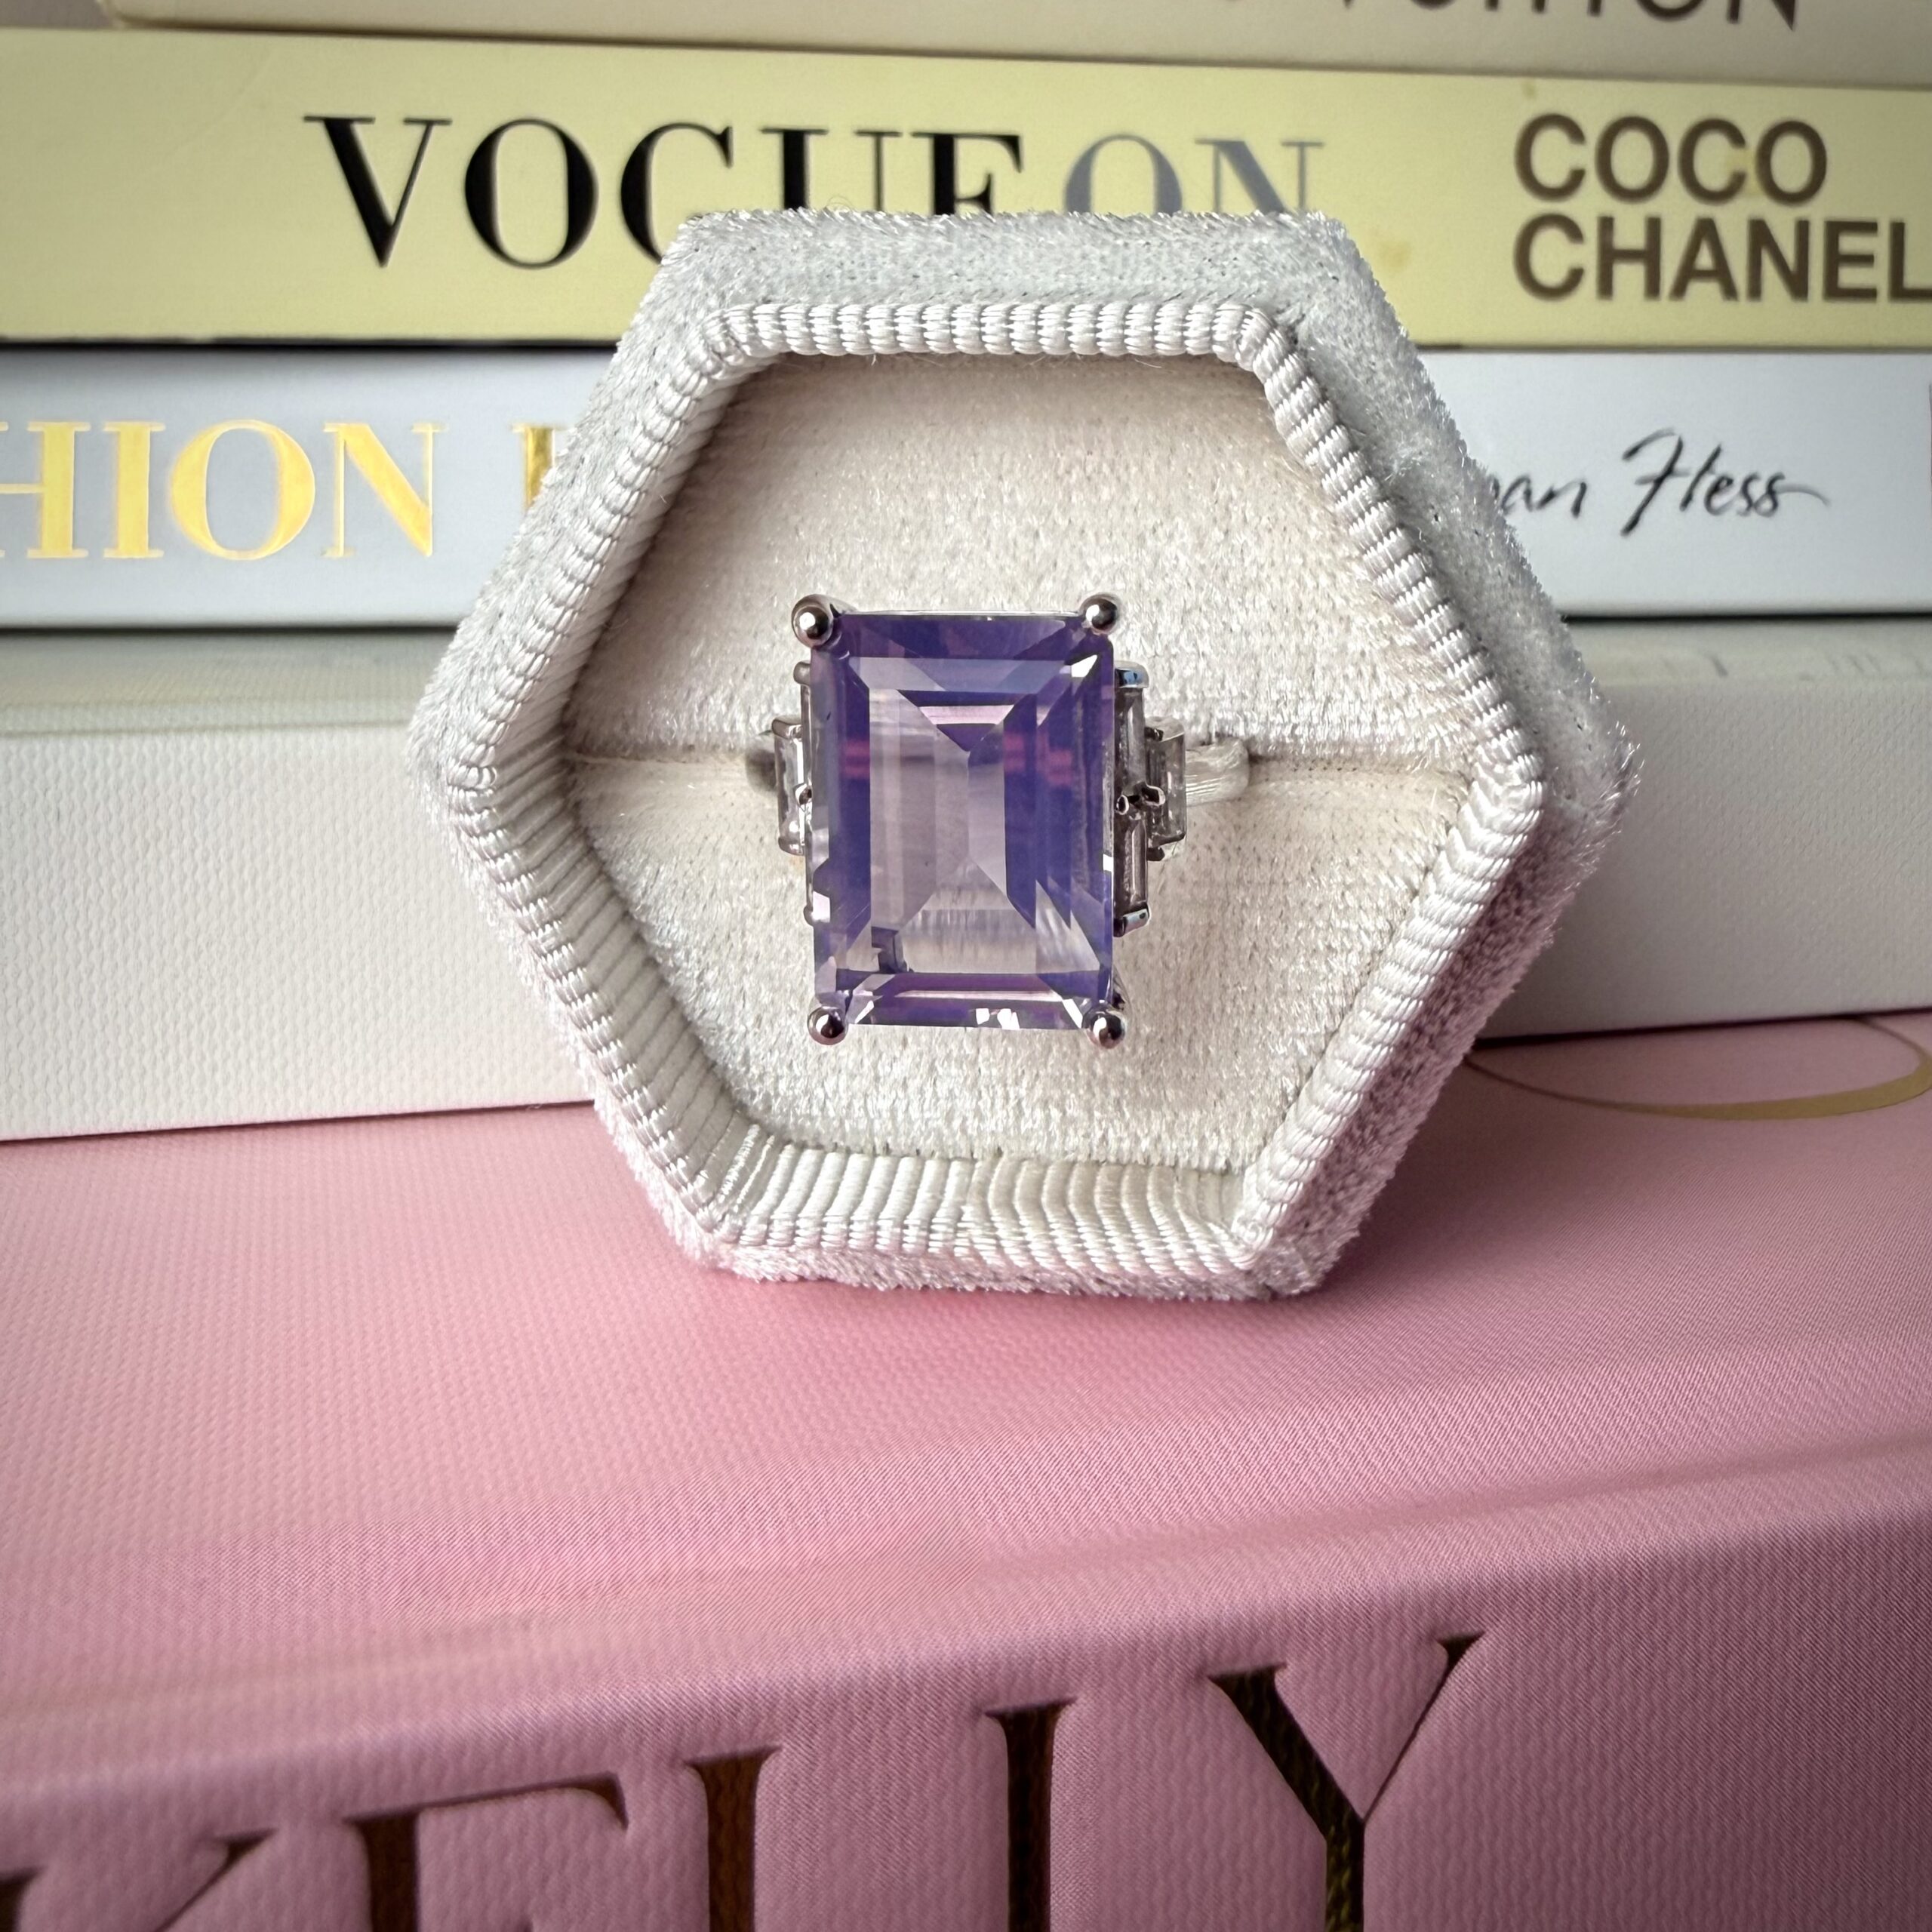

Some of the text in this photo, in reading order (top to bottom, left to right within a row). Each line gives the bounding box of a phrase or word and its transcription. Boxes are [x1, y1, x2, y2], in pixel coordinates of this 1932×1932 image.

[1515, 113, 1827, 206] COCO
[1513, 212, 1932, 302] CHANEL
[1490, 473, 1588, 518] an
